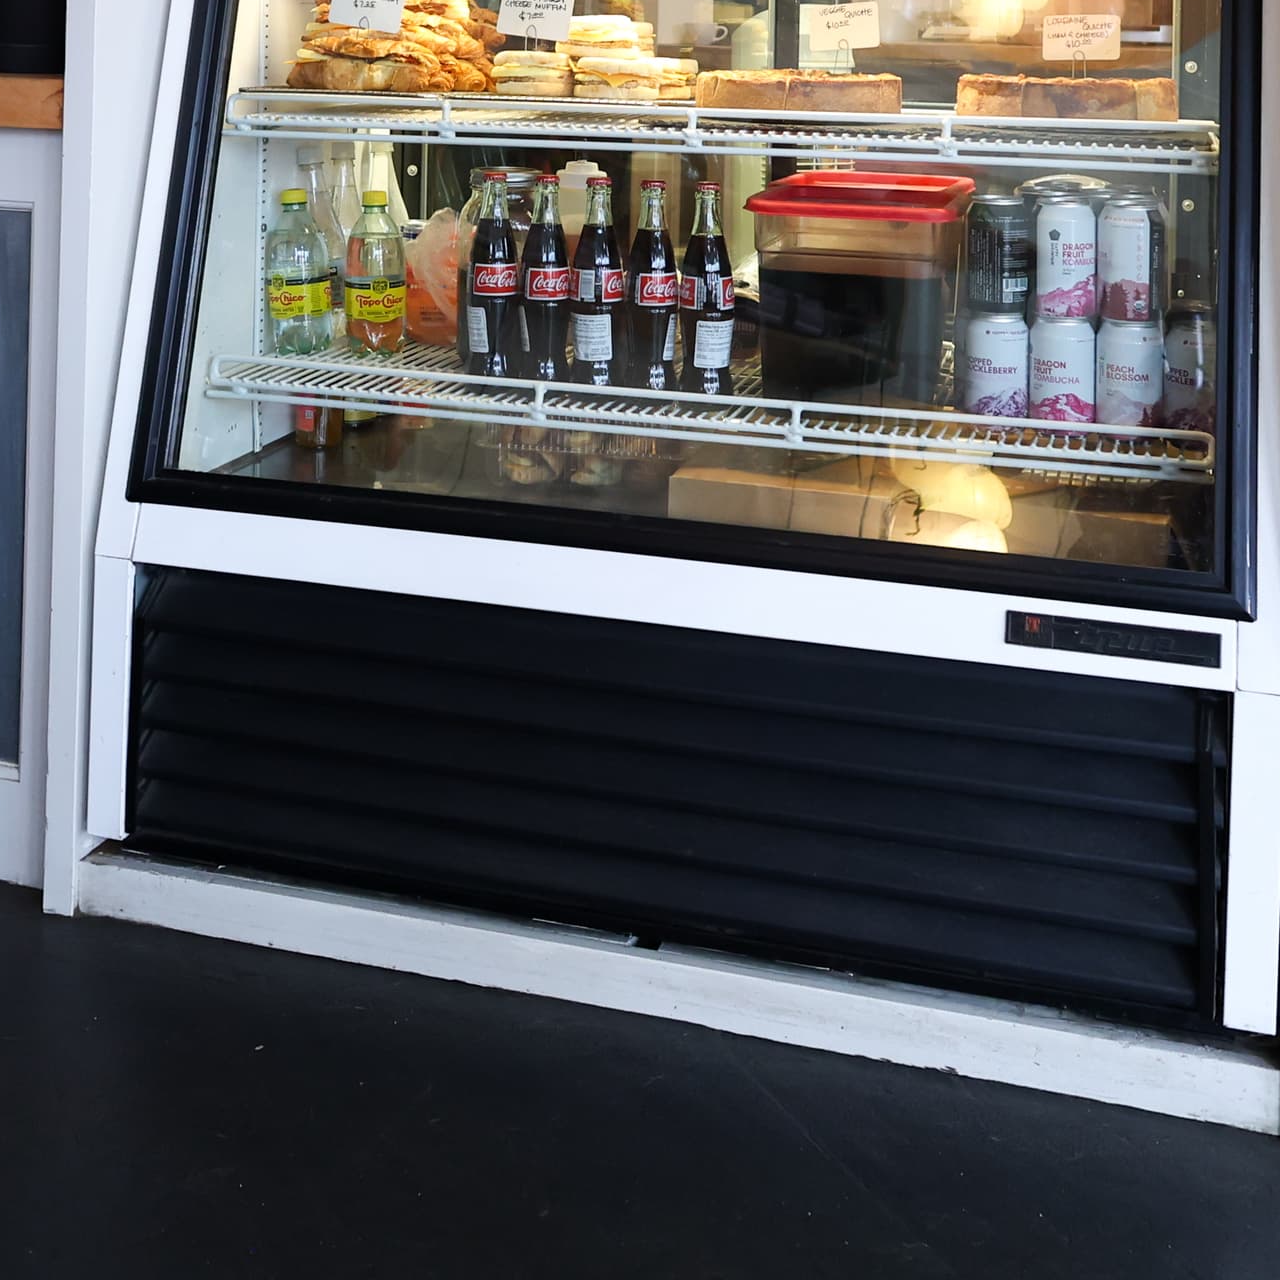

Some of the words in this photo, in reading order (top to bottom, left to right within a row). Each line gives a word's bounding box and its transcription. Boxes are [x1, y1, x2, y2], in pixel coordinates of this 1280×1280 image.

[505, 0, 532, 8] CHEESE
[1062, 243, 1094, 251] DRAGON
[968, 356, 993, 366] OPPED
[1034, 357, 1067, 369] DRAGON
[968, 364, 1018, 375] UCKLEBERRY
[1034, 366, 1052, 375] FRUIT
[1106, 363, 1135, 373] PEACH
[1034, 374, 1080, 385] KOMBUCHA
[1106, 371, 1150, 383] BLOSSOM
